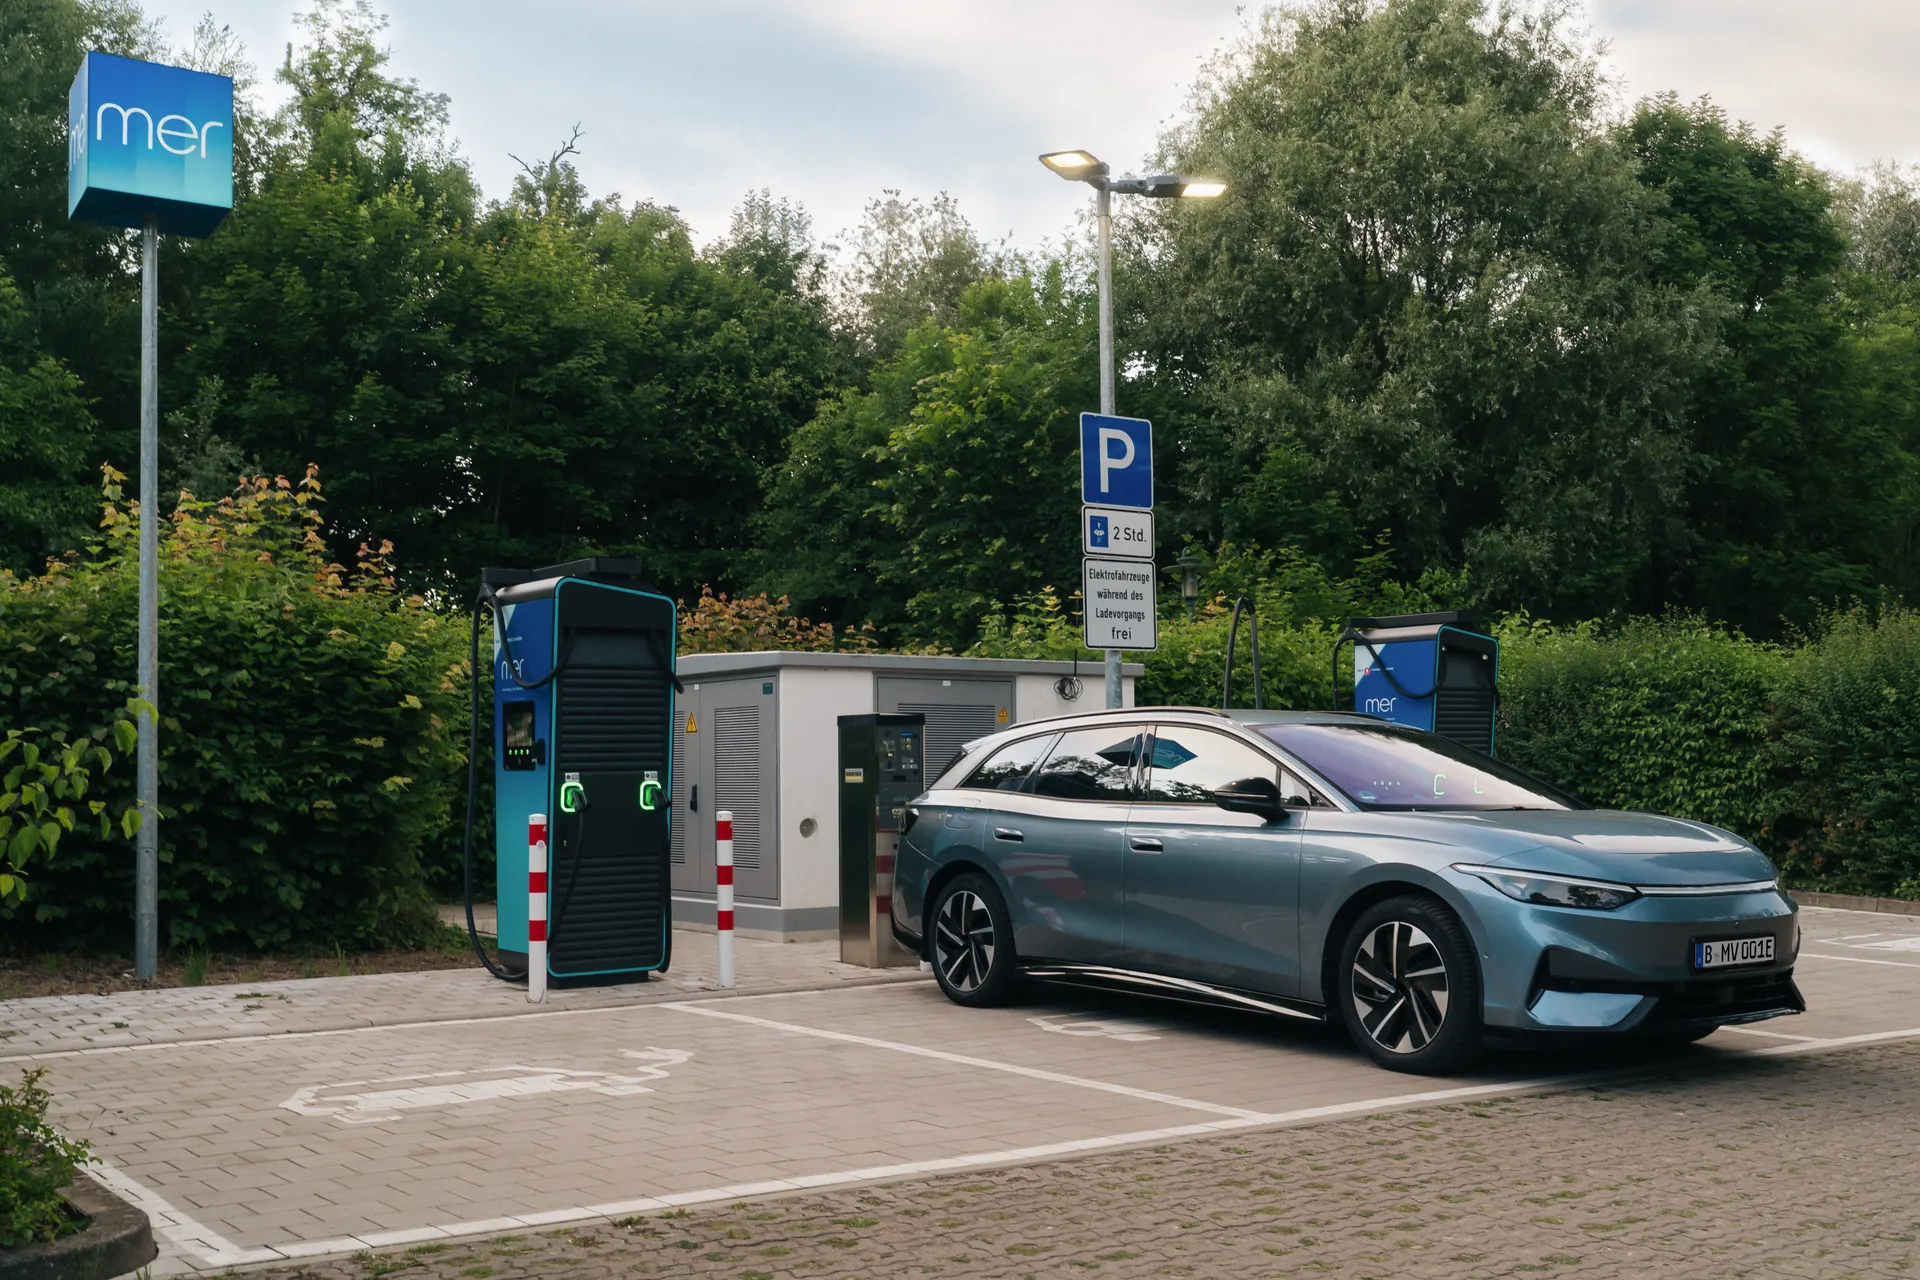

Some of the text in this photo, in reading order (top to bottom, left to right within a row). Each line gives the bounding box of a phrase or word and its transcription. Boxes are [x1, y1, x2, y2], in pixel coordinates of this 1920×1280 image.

[96, 102, 224, 159] mer
[70, 107, 87, 171] me
[1099, 427, 1135, 493] P
[1113, 526, 1147, 542] 2 Std.
[1089, 568, 1150, 584] Elektrofahrzeuge
[1097, 588, 1144, 601] während des
[1095, 607, 1146, 622] Ladevorgangs
[1111, 627, 1132, 640] frei
[1365, 697, 1397, 713] mer
[1705, 945, 1712, 964] B
